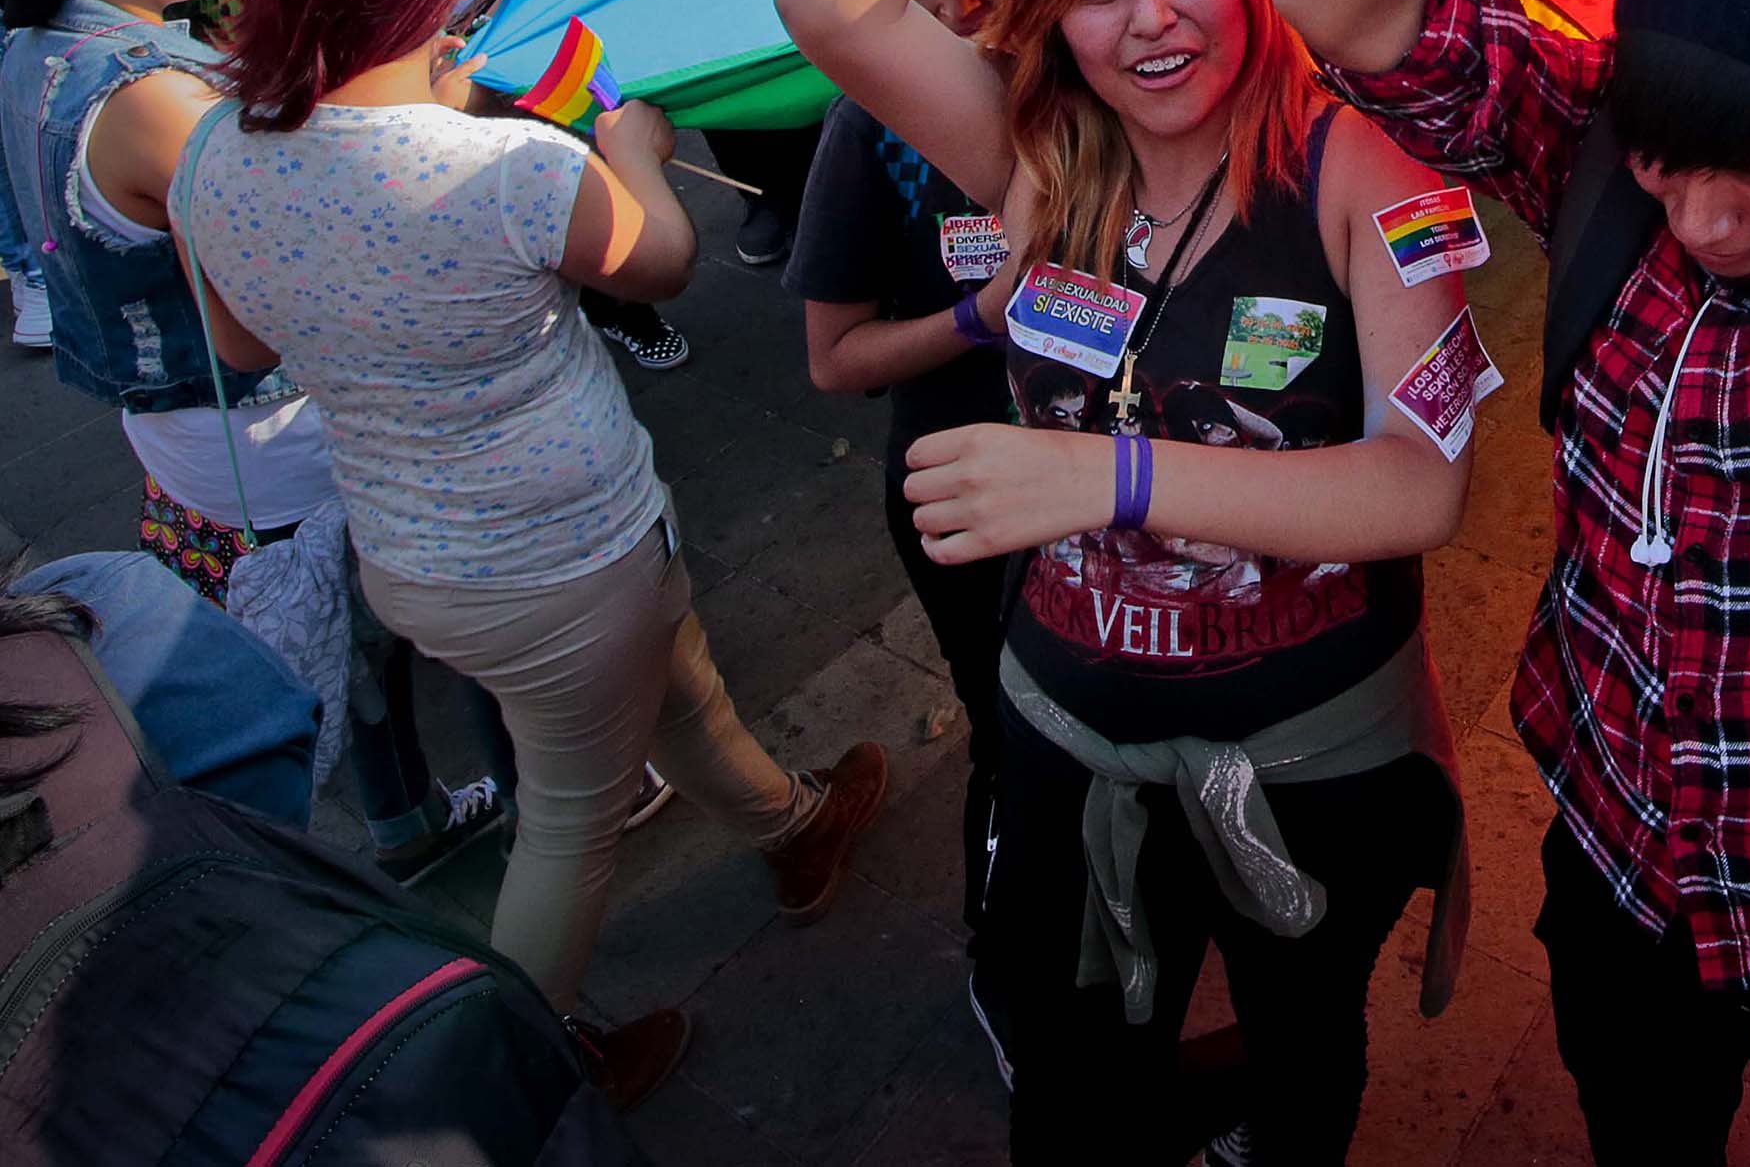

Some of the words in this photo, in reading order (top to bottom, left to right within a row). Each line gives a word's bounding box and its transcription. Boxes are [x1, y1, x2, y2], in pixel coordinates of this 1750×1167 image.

[956, 233, 1006, 244] DIVERSI
[957, 243, 1004, 253] SEXUAL
[1034, 275, 1048, 287] LA
[1033, 293, 1052, 313] SÍ
[1050, 299, 1116, 335] EXISTE
[1089, 587, 1194, 658] VEIL
